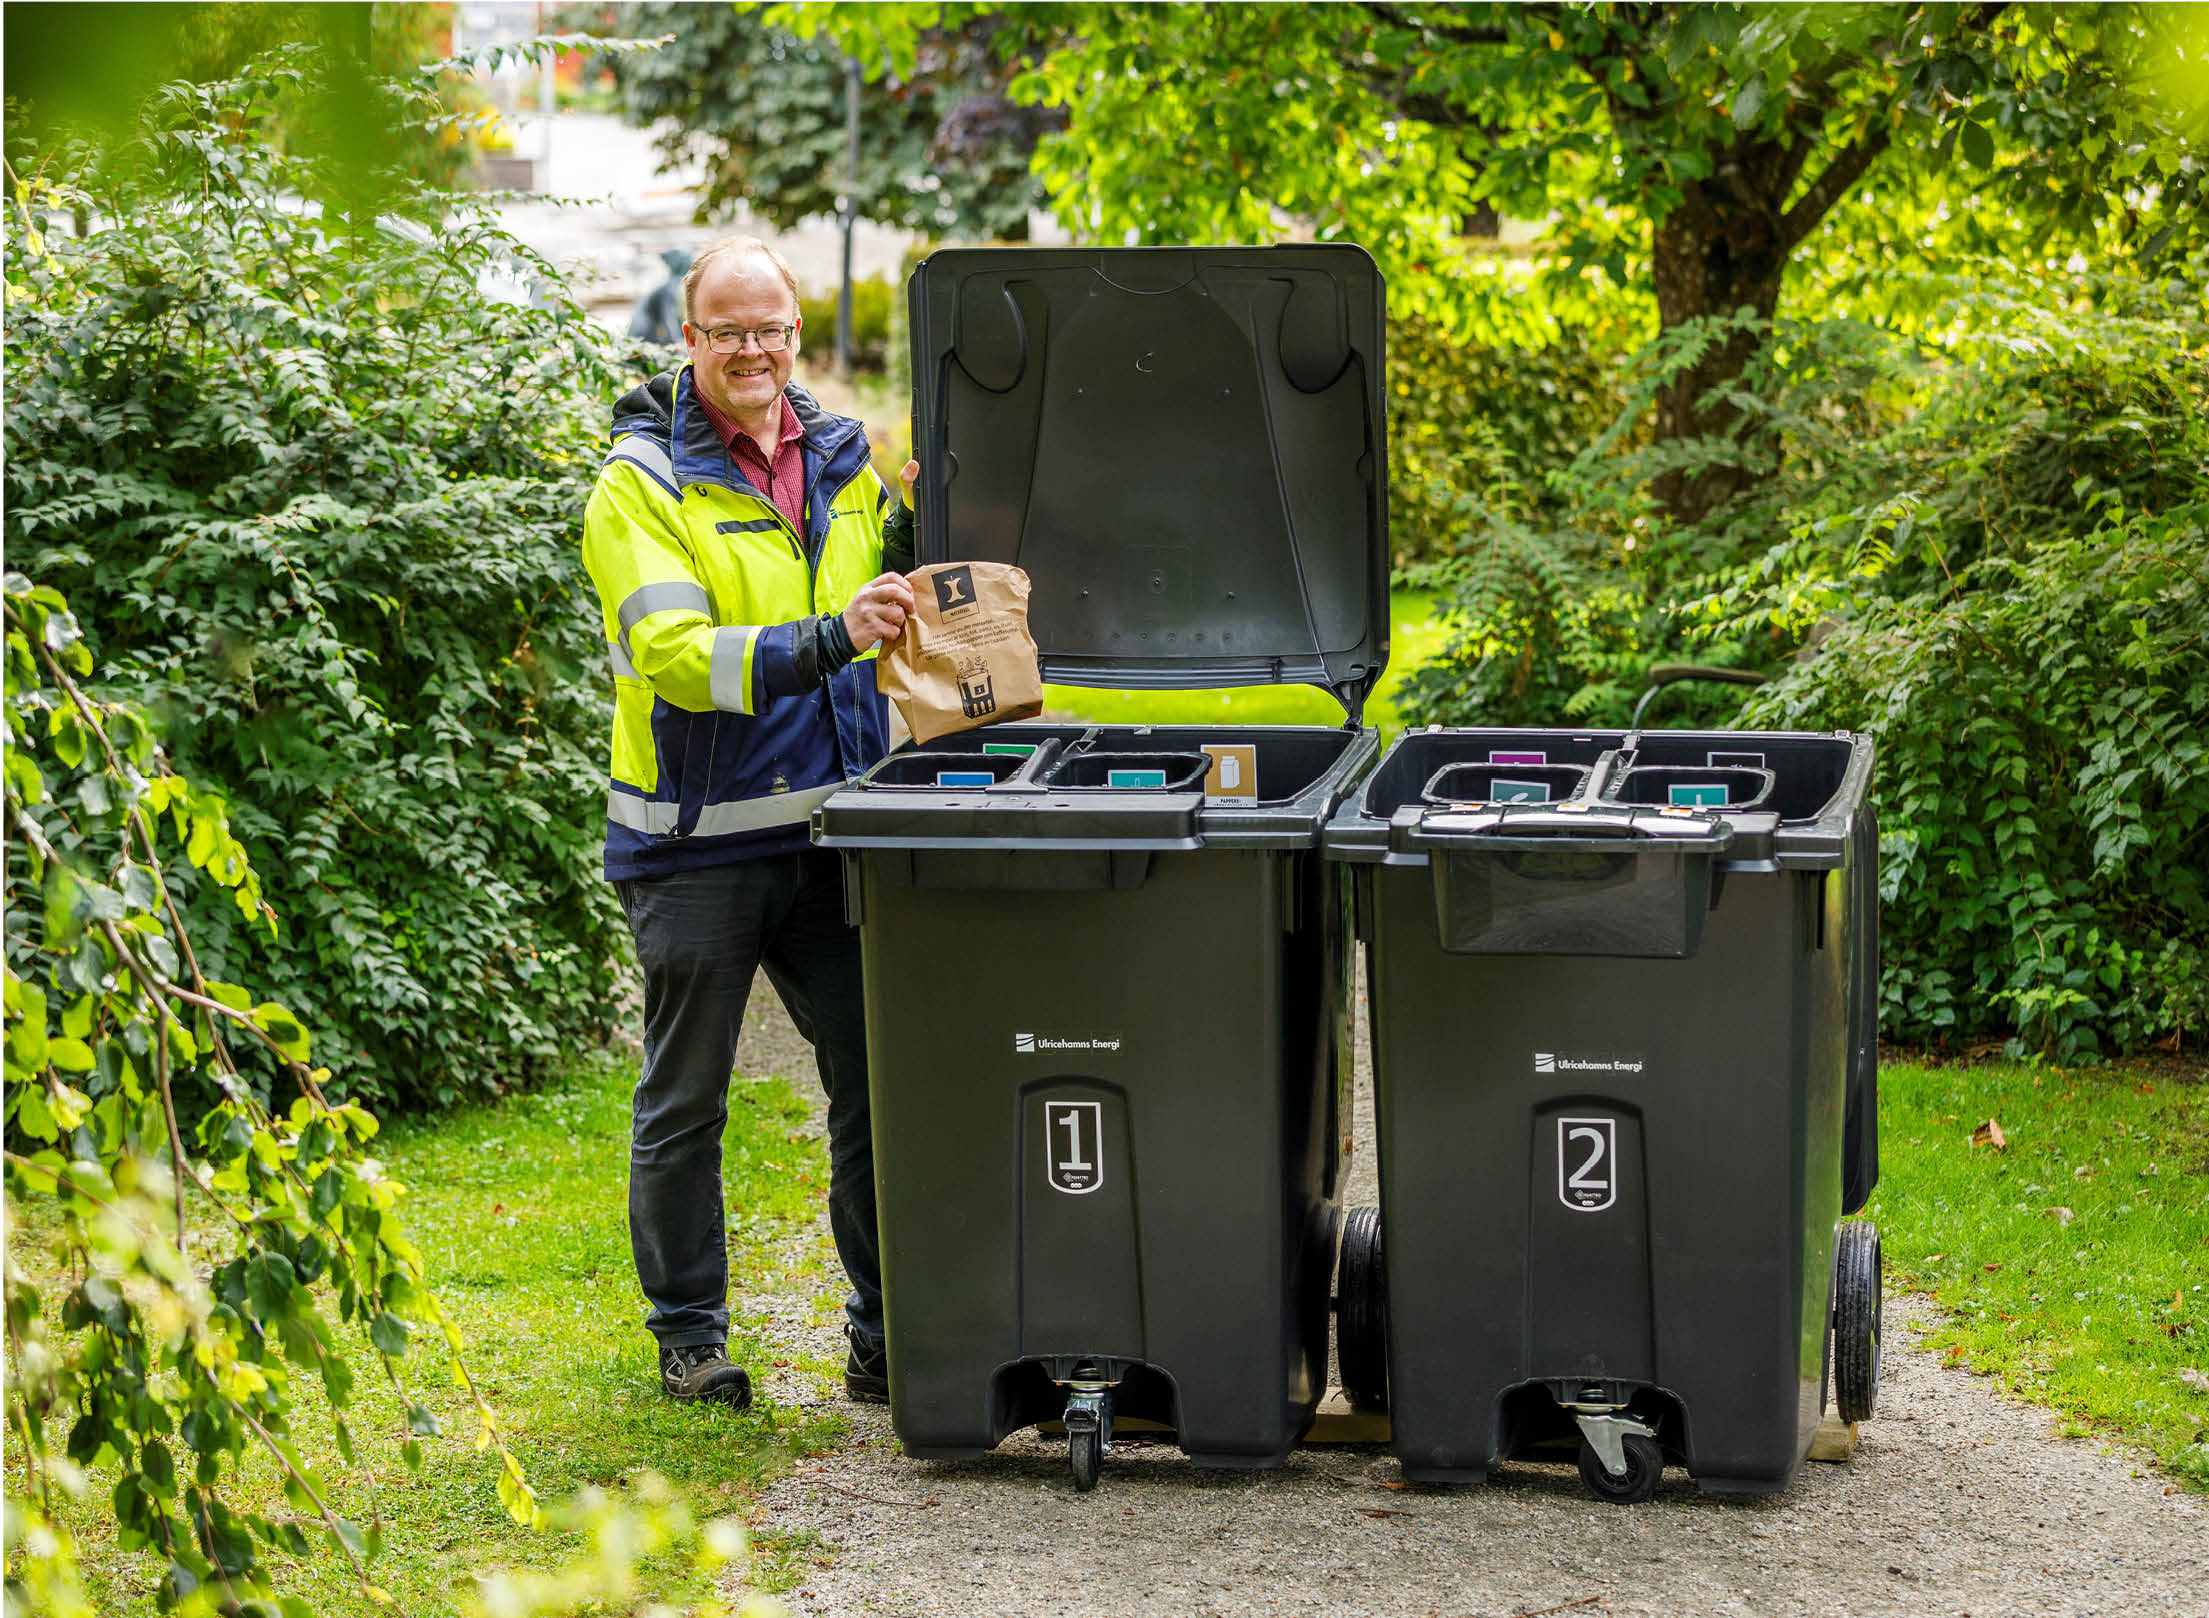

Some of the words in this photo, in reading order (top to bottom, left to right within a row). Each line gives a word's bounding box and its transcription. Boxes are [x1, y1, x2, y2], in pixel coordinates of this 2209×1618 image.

[1038, 1039, 1090, 1048] Ulricehamns
[1092, 1039, 1120, 1051] Energi
[1558, 1059, 1612, 1070] Ulricehamns
[1614, 1061, 1643, 1073] Energi
[1058, 1109, 1092, 1170] 1
[1568, 1127, 1608, 1189] 2
